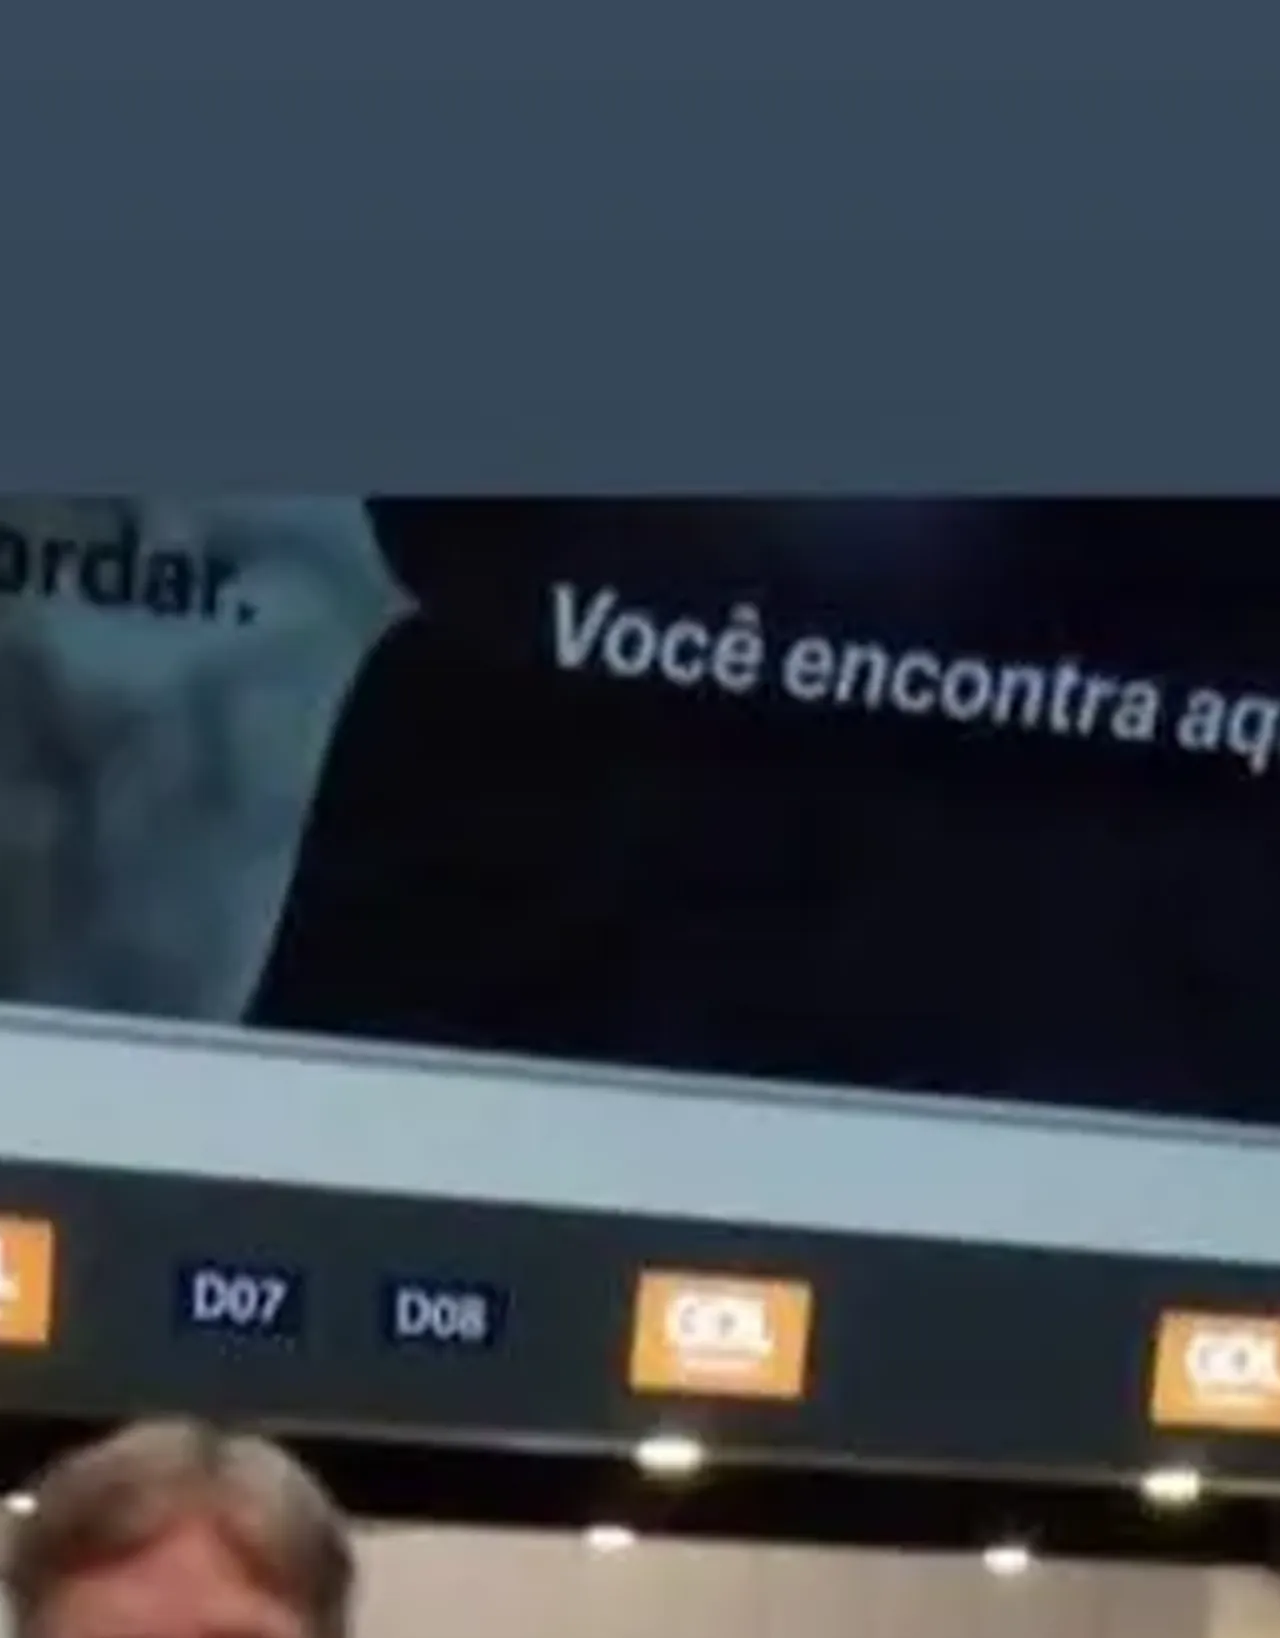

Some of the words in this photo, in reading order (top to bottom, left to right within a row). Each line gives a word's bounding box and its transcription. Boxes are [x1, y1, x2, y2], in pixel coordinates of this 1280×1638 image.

[550, 582, 764, 692] Você
[782, 636, 1160, 740] encontra
[191, 1272, 288, 1324] D07
[395, 1288, 490, 1340] D08
[665, 1292, 775, 1356] GOL
